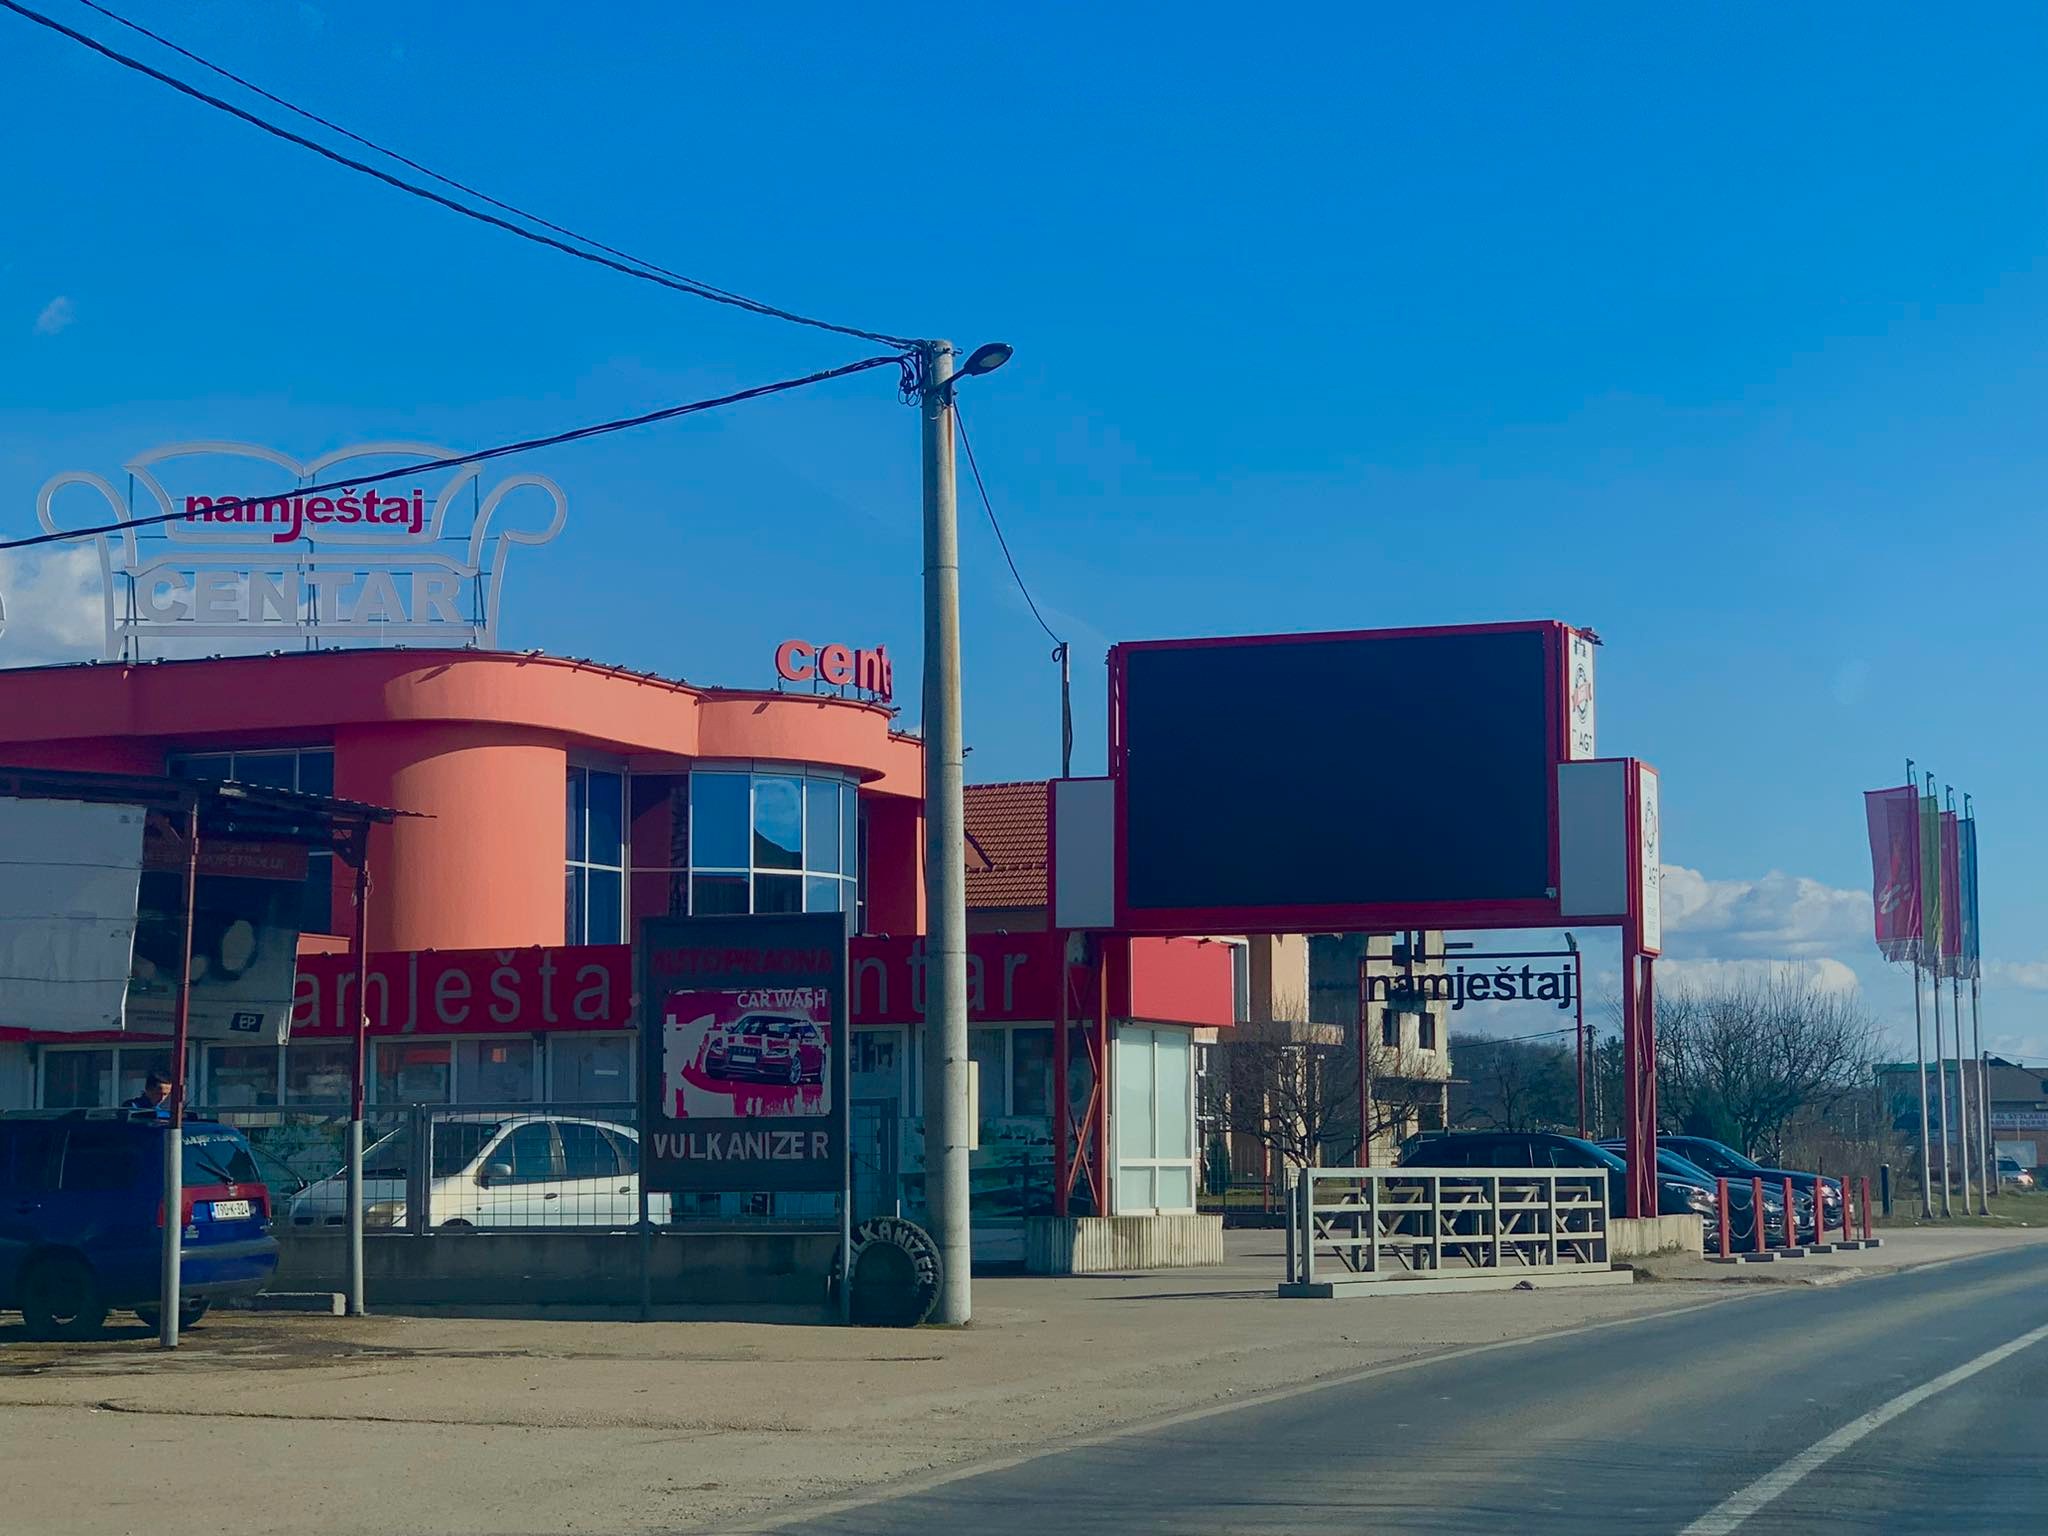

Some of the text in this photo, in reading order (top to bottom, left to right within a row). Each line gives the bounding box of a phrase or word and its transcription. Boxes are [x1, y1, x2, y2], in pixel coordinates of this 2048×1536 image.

[185, 488, 424, 543] namještaj
[137, 569, 466, 624] CENTAR
[290, 938, 1028, 1033] amještaj ntar
[736, 988, 828, 1010] CAR WASH
[1367, 964, 1571, 1011] namještaj
[238, 1014, 257, 1030] EP
[652, 1131, 830, 1161] VULKANIZER
